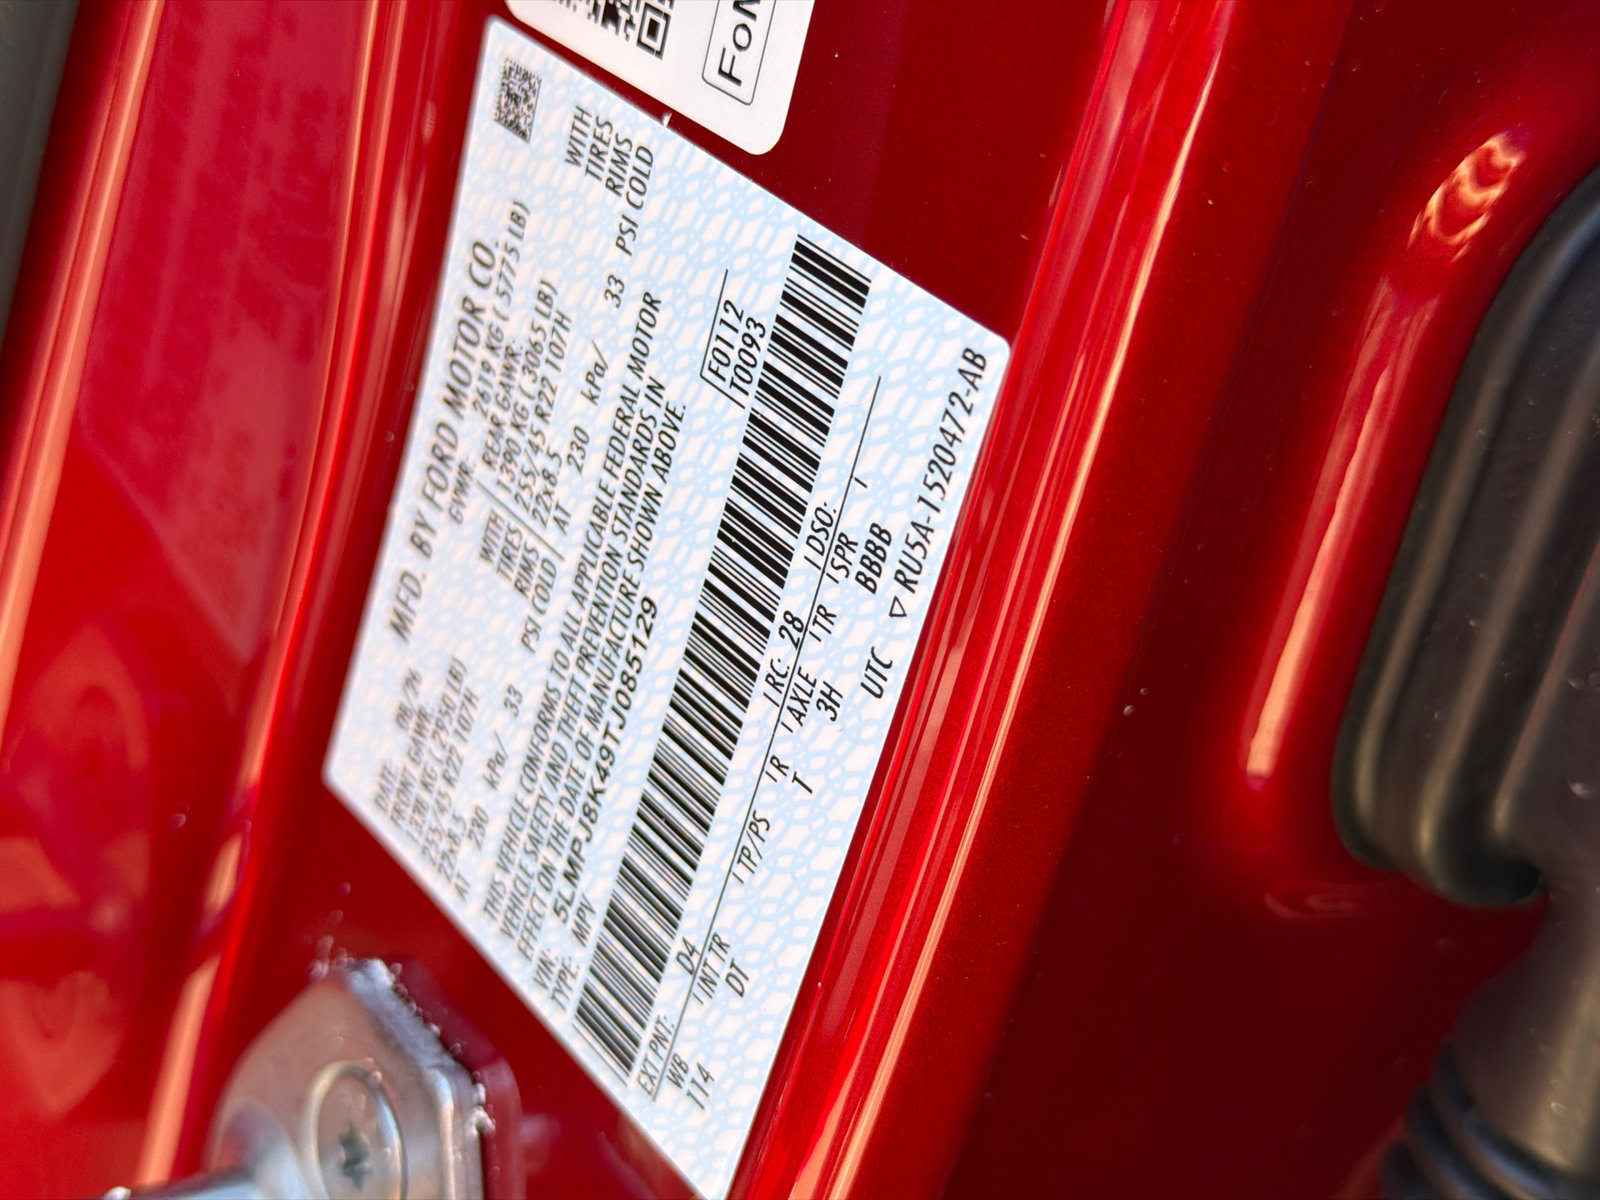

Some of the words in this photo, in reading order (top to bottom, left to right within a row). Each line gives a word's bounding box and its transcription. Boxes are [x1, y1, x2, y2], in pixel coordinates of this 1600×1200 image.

[564, 104, 592, 168] WITH
[583, 114, 614, 183] TIRES
[604, 131, 633, 197] RIMS
[624, 144, 654, 211] COLD
[466, 233, 499, 292] CO.
[614, 213, 638, 256] PSI
[471, 357, 496, 419] 2619
[484, 322, 504, 357] KG
[506, 198, 530, 241] LB)
[603, 273, 625, 308] 33
[441, 293, 487, 420] MOTOR
[544, 308, 572, 373] 107H
[625, 290, 662, 380] MOTOR
[706, 298, 744, 382] F0112
[728, 315, 767, 398] T0093
[481, 413, 505, 470] REAR
[493, 337, 523, 413] GAWR:
[495, 435, 522, 495] 1390
[509, 400, 529, 435] KG
[533, 277, 557, 320] LB)
[533, 374, 557, 424] R22
[565, 424, 590, 474] 230
[602, 381, 641, 480] FEDERAL
[649, 397, 686, 483] ABOVE.
[420, 417, 459, 513] FORD
[513, 423, 549, 514] 255/45
[531, 445, 562, 528] 22x8.5
[409, 508, 437, 559] BY
[478, 508, 504, 566] WITH
[552, 500, 571, 535] AT
[570, 478, 616, 610] APPLICABLE
[626, 482, 663, 572] SHOWN
[805, 499, 837, 556] DSO:
[859, 645, 893, 699] UTC
[890, 346, 990, 594] RU5A-1520472-AB
[495, 521, 523, 583] TIRES
[513, 540, 539, 599] RIMS
[829, 530, 858, 578] SPR
[854, 521, 893, 594] BBBB
[530, 555, 557, 616] COLD
[520, 614, 541, 654] PSI
[559, 607, 582, 652] ALL
[583, 568, 640, 731] MANUFACTURE
[811, 602, 837, 636] TR
[500, 856, 535, 942] VEHICLE
[523, 785, 554, 863] SAFETY
[544, 739, 568, 792] AND
[556, 673, 587, 742] THEFT
[575, 542, 623, 677] PREVENTION
[609, 407, 658, 543] STANDARDS
[644, 375, 665, 408] IN
[549, 647, 570, 683] TO
[764, 655, 790, 694] RC:
[777, 608, 806, 650] 28
[503, 682, 523, 718] 33
[785, 665, 817, 727] AXLE
[815, 680, 843, 722] 3H
[518, 679, 561, 797] CONFORMS
[574, 725, 595, 762] OF
[769, 753, 789, 776] R
[532, 945, 558, 992] VIN:
[552, 593, 658, 925] 5LMPJ8K49TJ085129
[558, 758, 586, 818] DATE
[791, 770, 813, 795] T
[495, 792, 530, 877] VEHICLE
[546, 812, 570, 858] THE
[736, 808, 771, 877] TP/PS
[482, 872, 507, 923] THIS
[536, 855, 557, 894] ON
[517, 887, 548, 963] EFFECT
[550, 953, 579, 1012] TYPE:
[570, 892, 596, 947] MPV
[707, 931, 730, 964] TR
[696, 957, 720, 999] INT
[724, 957, 749, 998] DT
[636, 1052, 660, 1098] EXT
[648, 1012, 674, 1061] PNT:
[675, 935, 700, 976] D4
[666, 1051, 689, 1090] WB
[686, 1061, 714, 1111] 114
